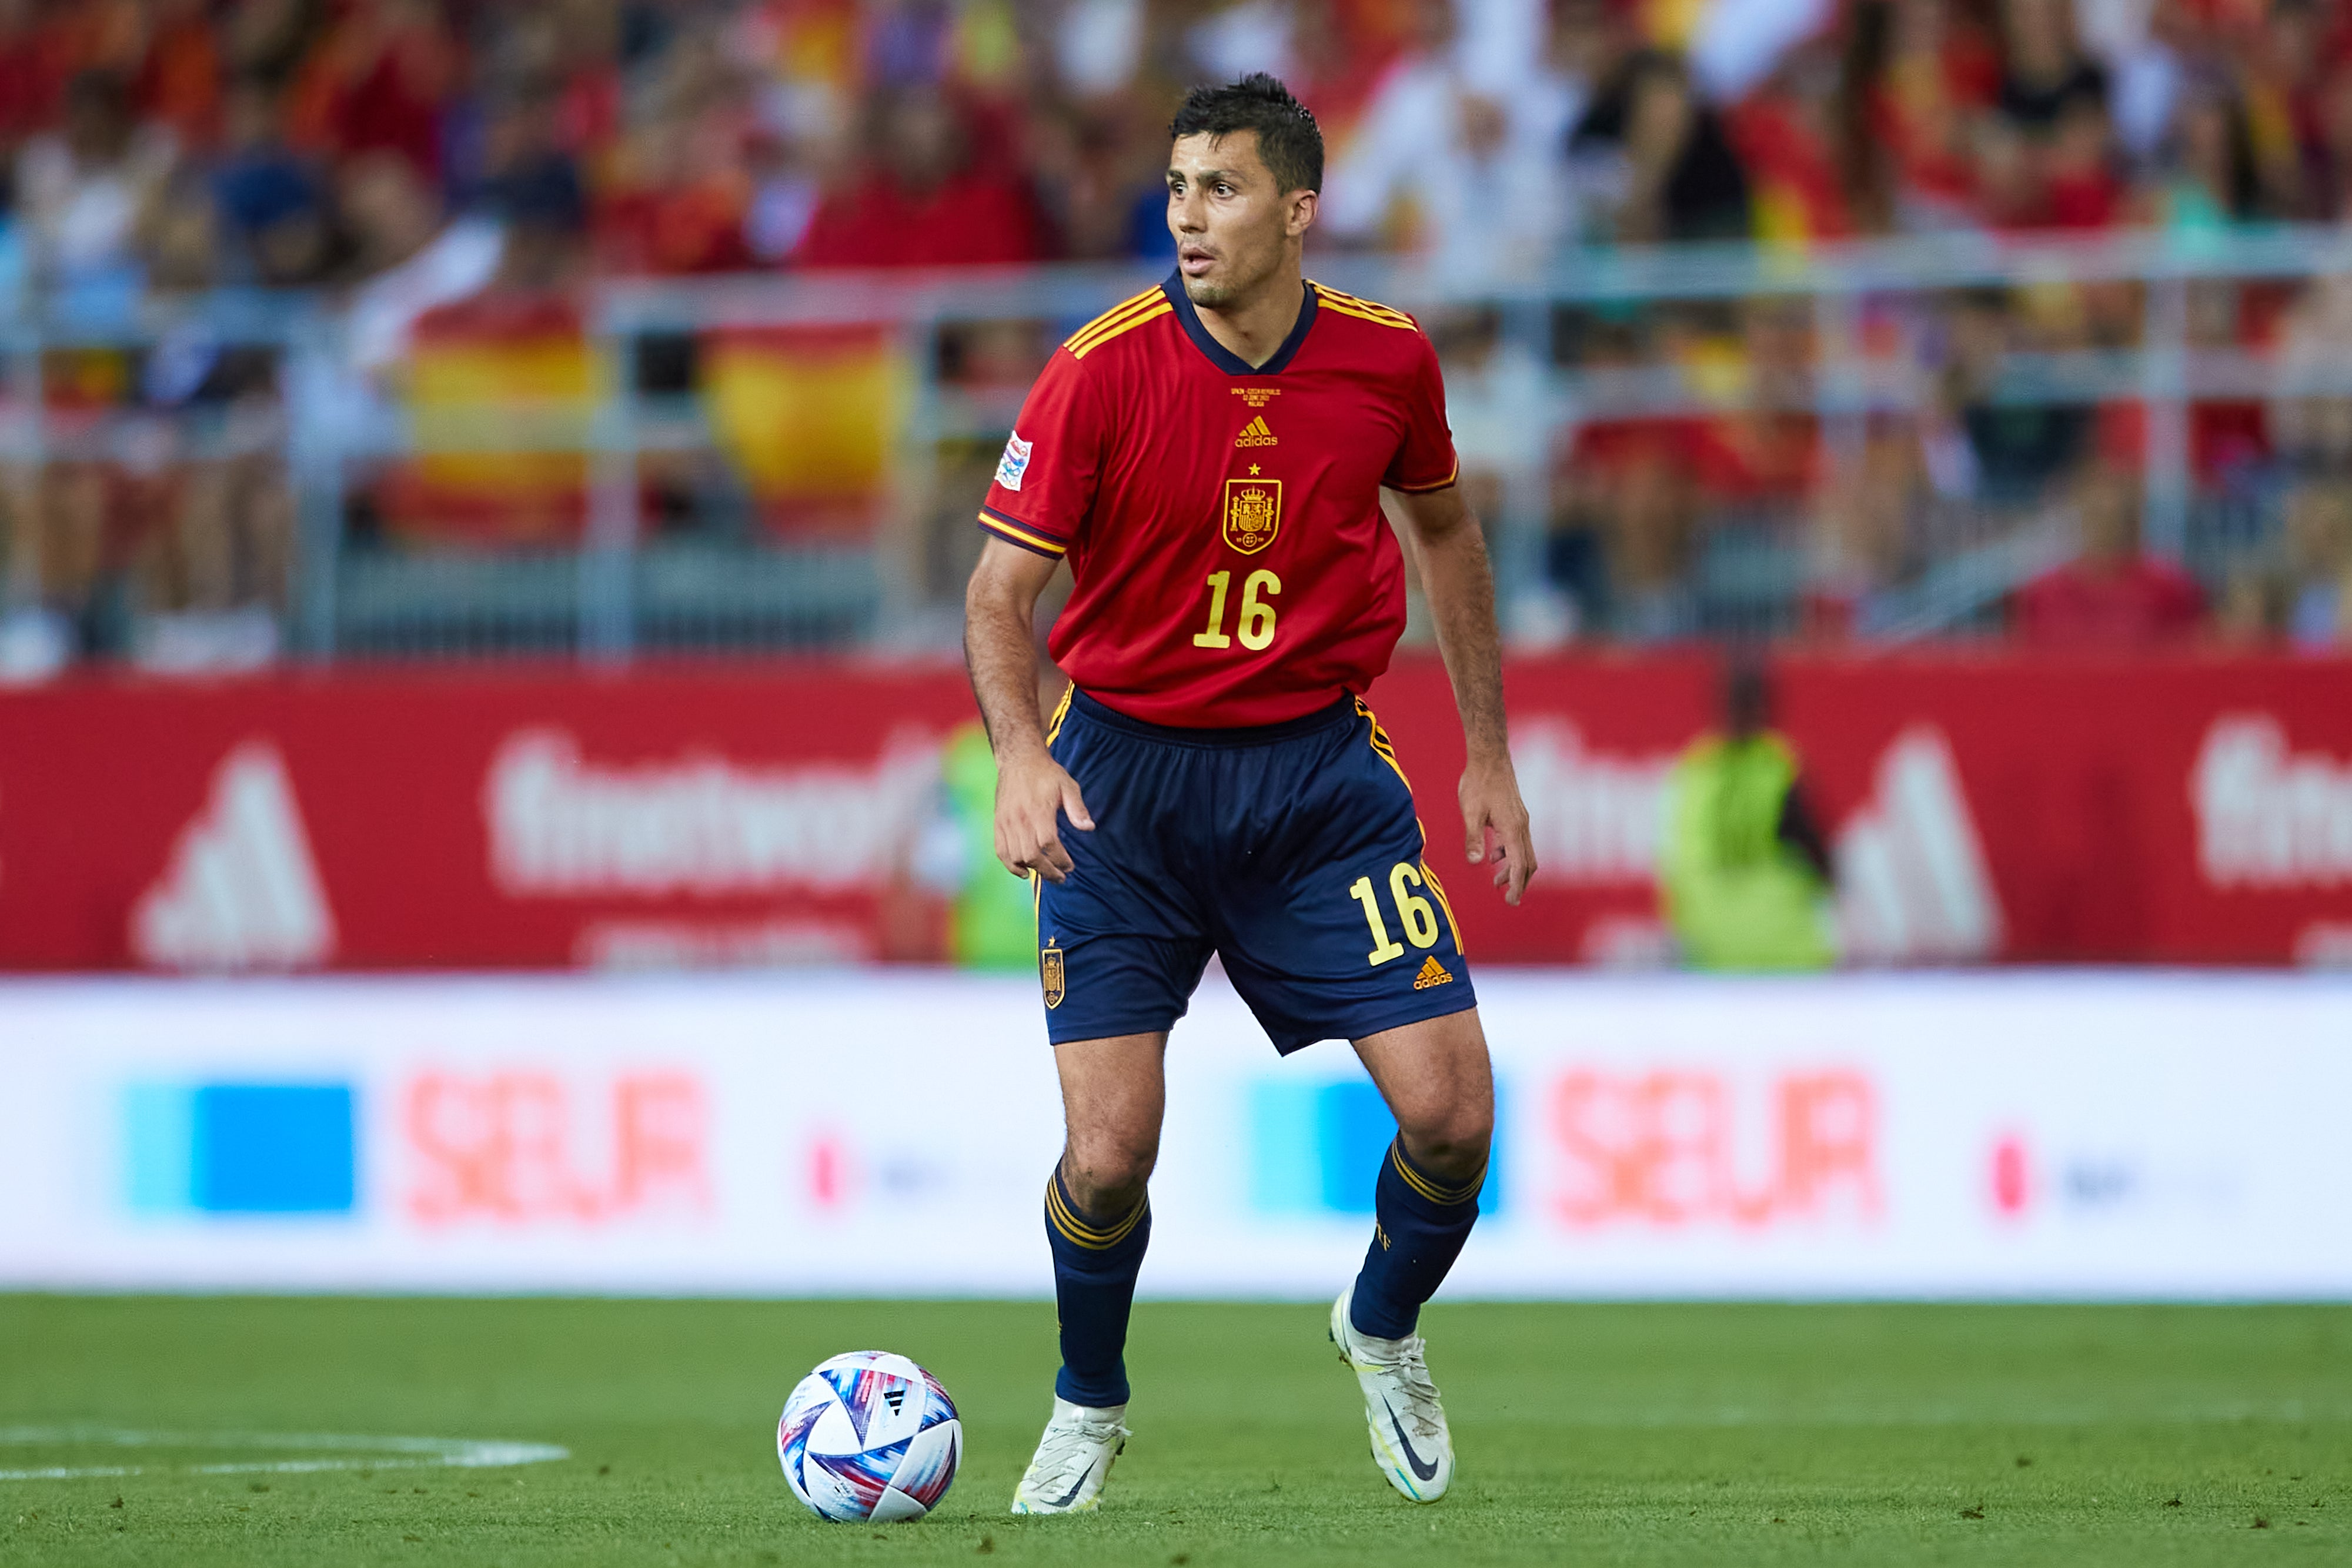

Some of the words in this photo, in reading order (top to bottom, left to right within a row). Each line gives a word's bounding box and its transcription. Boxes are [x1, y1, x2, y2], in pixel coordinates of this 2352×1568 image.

[1235, 436, 1278, 447] adidas
[1193, 569, 1282, 651] 16
[1349, 862, 1439, 967] 16
[1414, 972, 1453, 990] adidas
